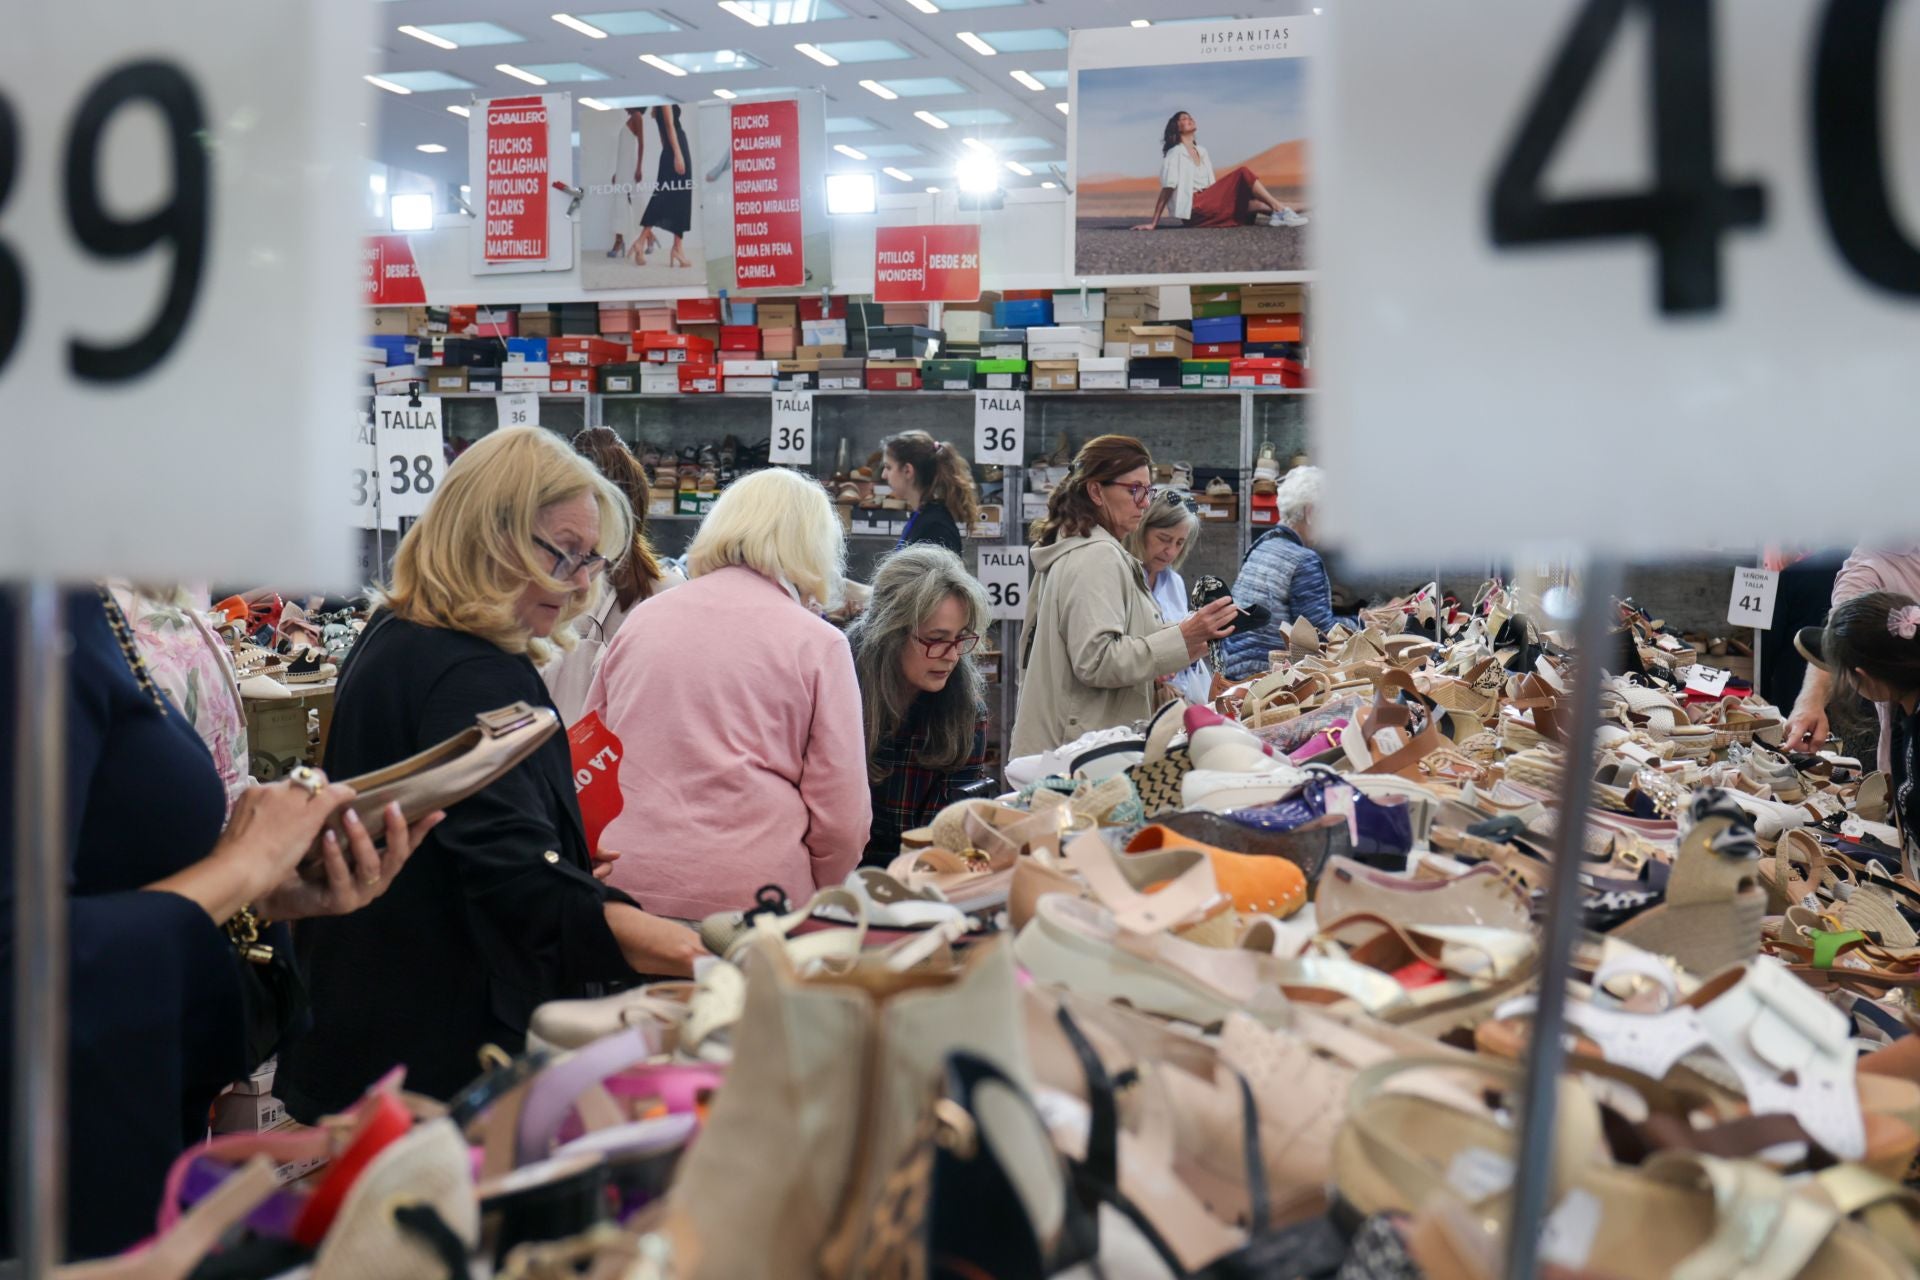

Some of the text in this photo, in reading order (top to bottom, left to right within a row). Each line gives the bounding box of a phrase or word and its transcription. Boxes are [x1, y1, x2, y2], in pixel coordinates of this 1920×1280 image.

[1201, 28, 1289, 44] HISPANITAS
[1201, 46, 1217, 54] JOY
[1224, 45, 1232, 53] IS
[1248, 42, 1288, 52] CHOICE
[488, 112, 547, 125] CABALLERO
[733, 115, 769, 130] FLUCHOS
[489, 137, 532, 154] FLUCHOS
[734, 136, 781, 151] CALLAGHAN
[489, 158, 547, 175] CALLAGHAN
[734, 157, 776, 172] PIKOLINOS
[489, 178, 539, 195] PIKOLINOS
[590, 183, 633, 195] PEDRO
[735, 179, 778, 194] HISPANITAS
[488, 198, 524, 215] CLARKS
[736, 199, 800, 215] PEDRO MIRALLES
[488, 220, 514, 236] DUDE
[736, 222, 768, 236] PITILLOS
[487, 240, 541, 256] MARTINELLI
[737, 242, 792, 258] ALMA EN PENA
[878, 250, 915, 265] PITILLOS
[929, 254, 978, 269] DESDE 29€
[385, 264, 410, 278] DESDE
[738, 264, 776, 279] CARMELA
[878, 268, 923, 282] WONDERS
[776, 399, 810, 412] TALLA
[980, 398, 1021, 411] TALLA
[381, 410, 437, 429] TALLA
[511, 410, 526, 424] 36
[778, 427, 804, 451] 36
[983, 427, 1015, 452] 36
[390, 455, 434, 494] 38
[982, 553, 1025, 566] TALLA
[1743, 571, 1769, 581] SEÑORA
[1745, 581, 1764, 589] TALLA
[987, 582, 1020, 606] 36
[1739, 595, 1762, 612] 41
[1699, 666, 1720, 682] 41
[588, 745, 619, 771] LA
